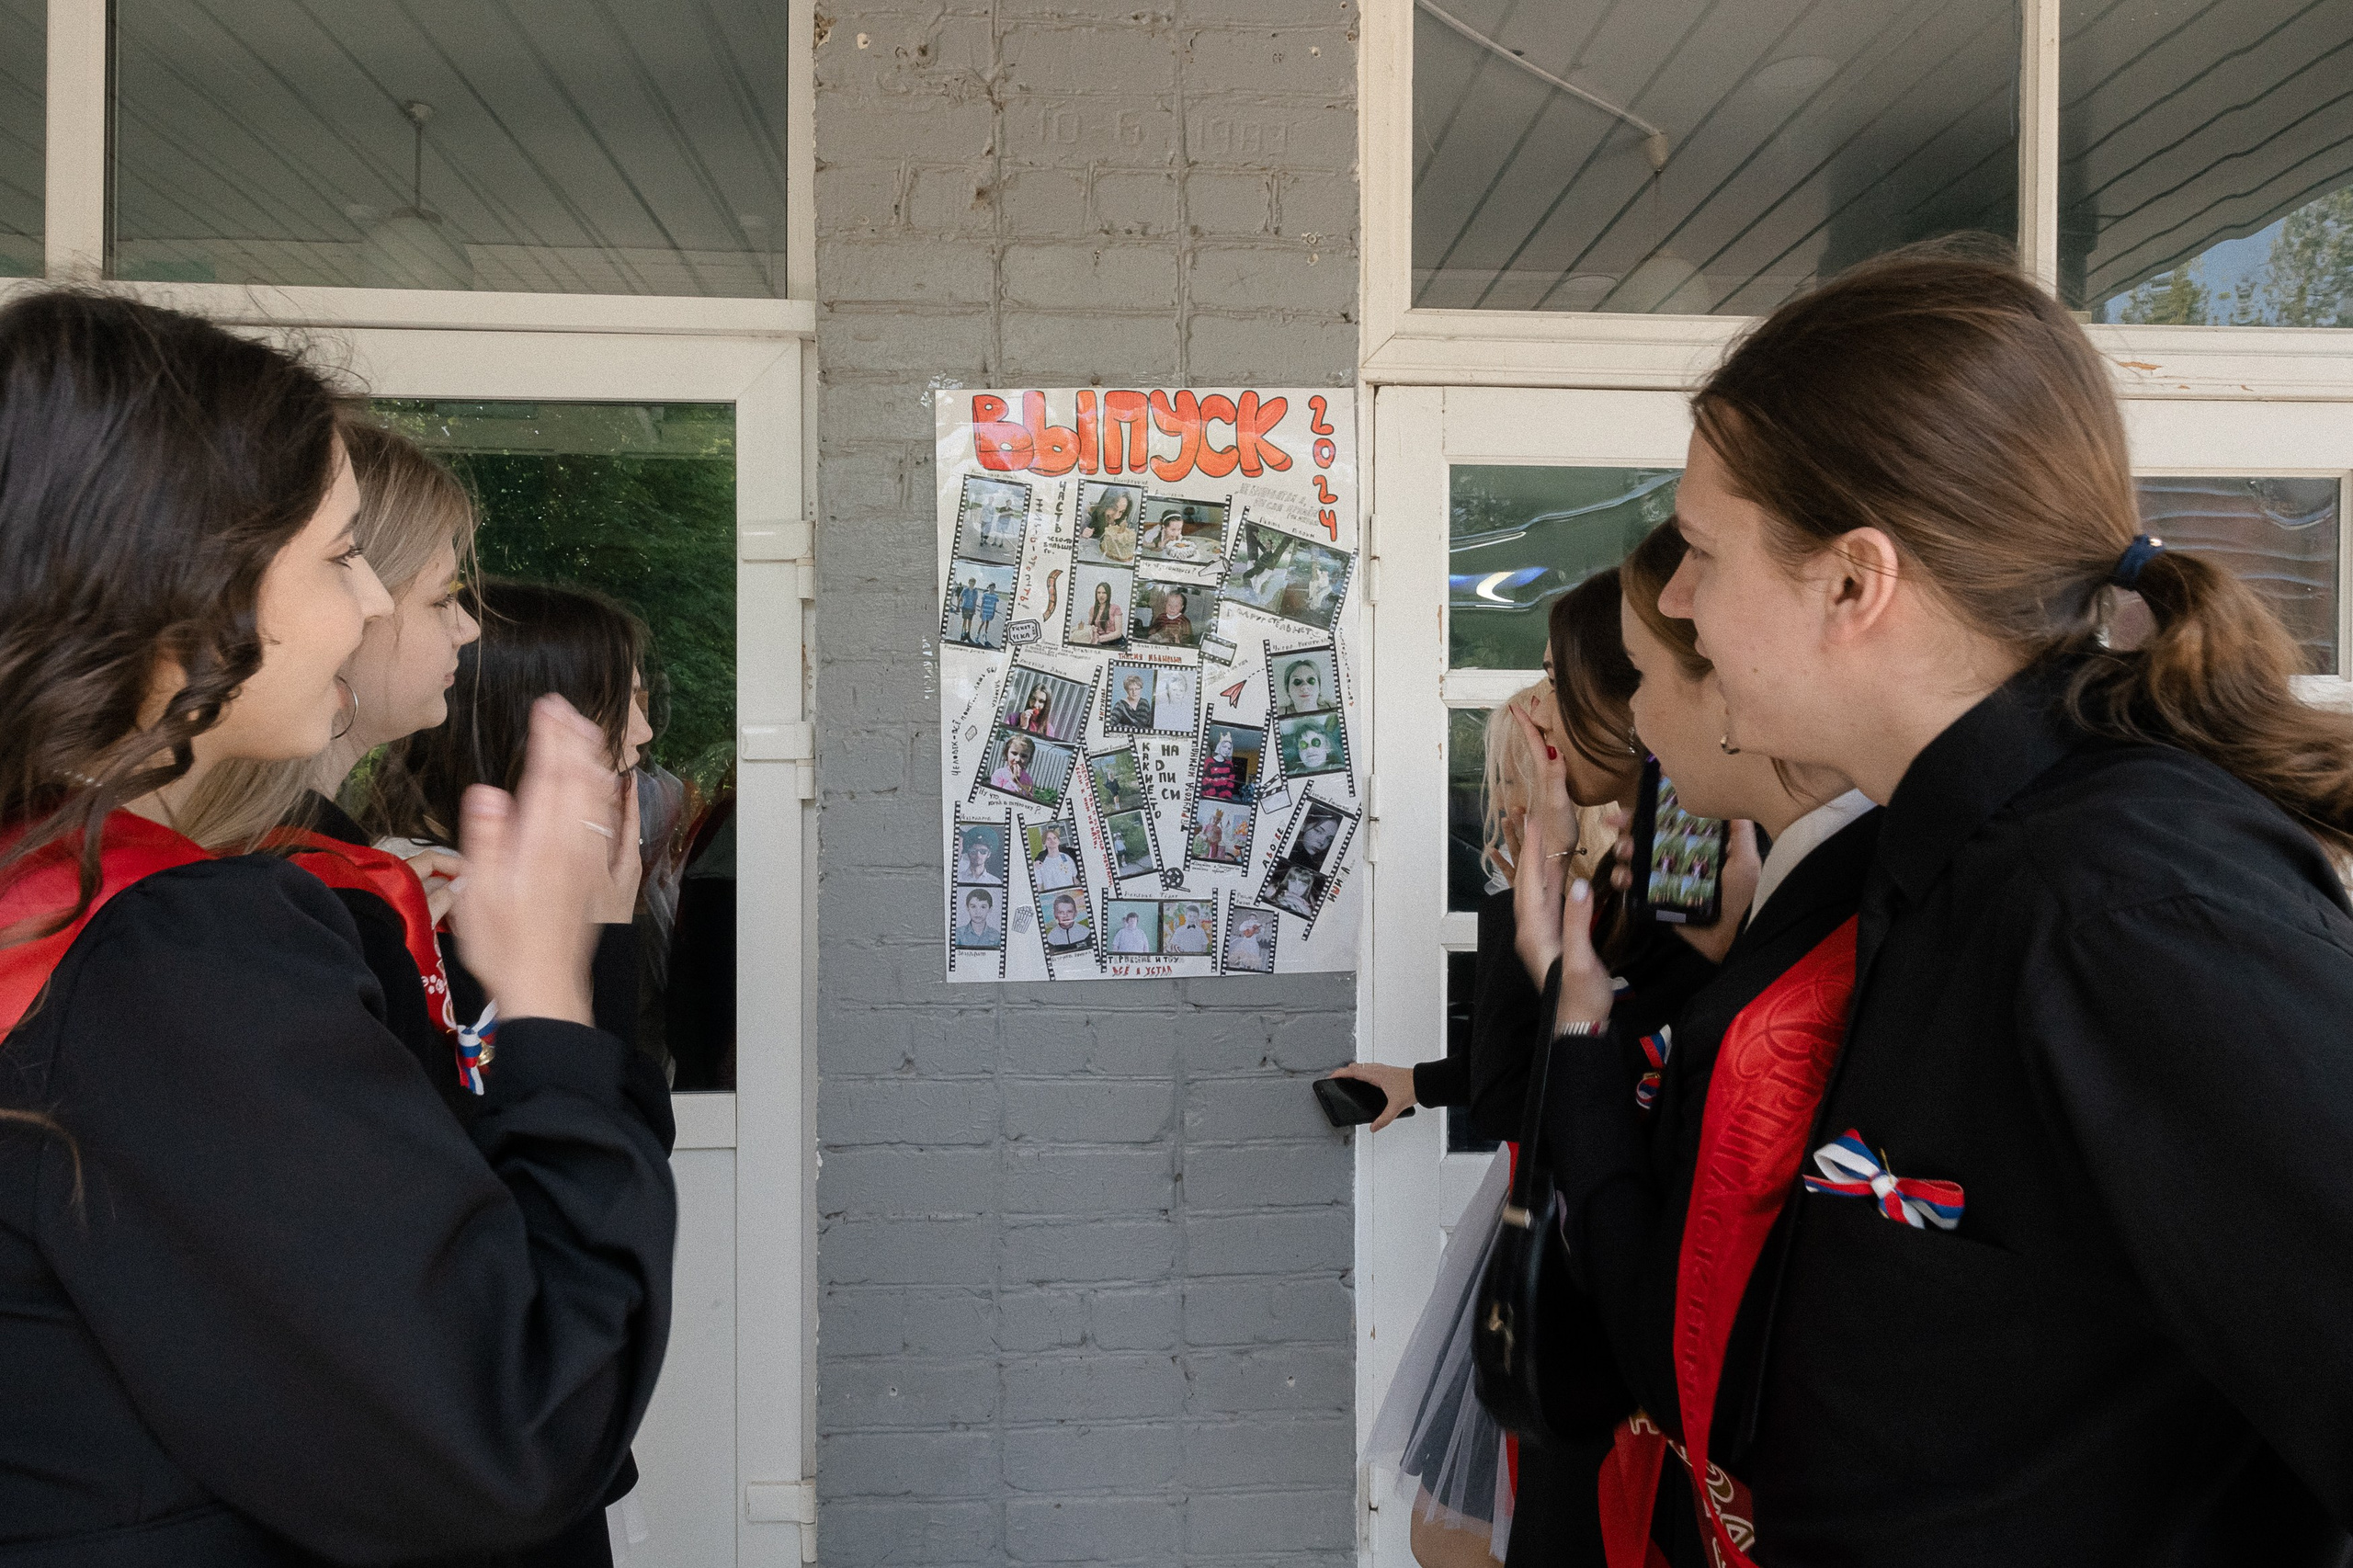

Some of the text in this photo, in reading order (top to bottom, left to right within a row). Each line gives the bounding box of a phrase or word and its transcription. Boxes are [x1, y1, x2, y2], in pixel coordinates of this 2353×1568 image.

[972, 389, 1294, 482] ВЫПУСК
[1308, 395, 1338, 542] 2024
[1054, 481, 1067, 533] ЧАСТЬ
[950, 742, 961, 776] ЧЕЛОВЕК
